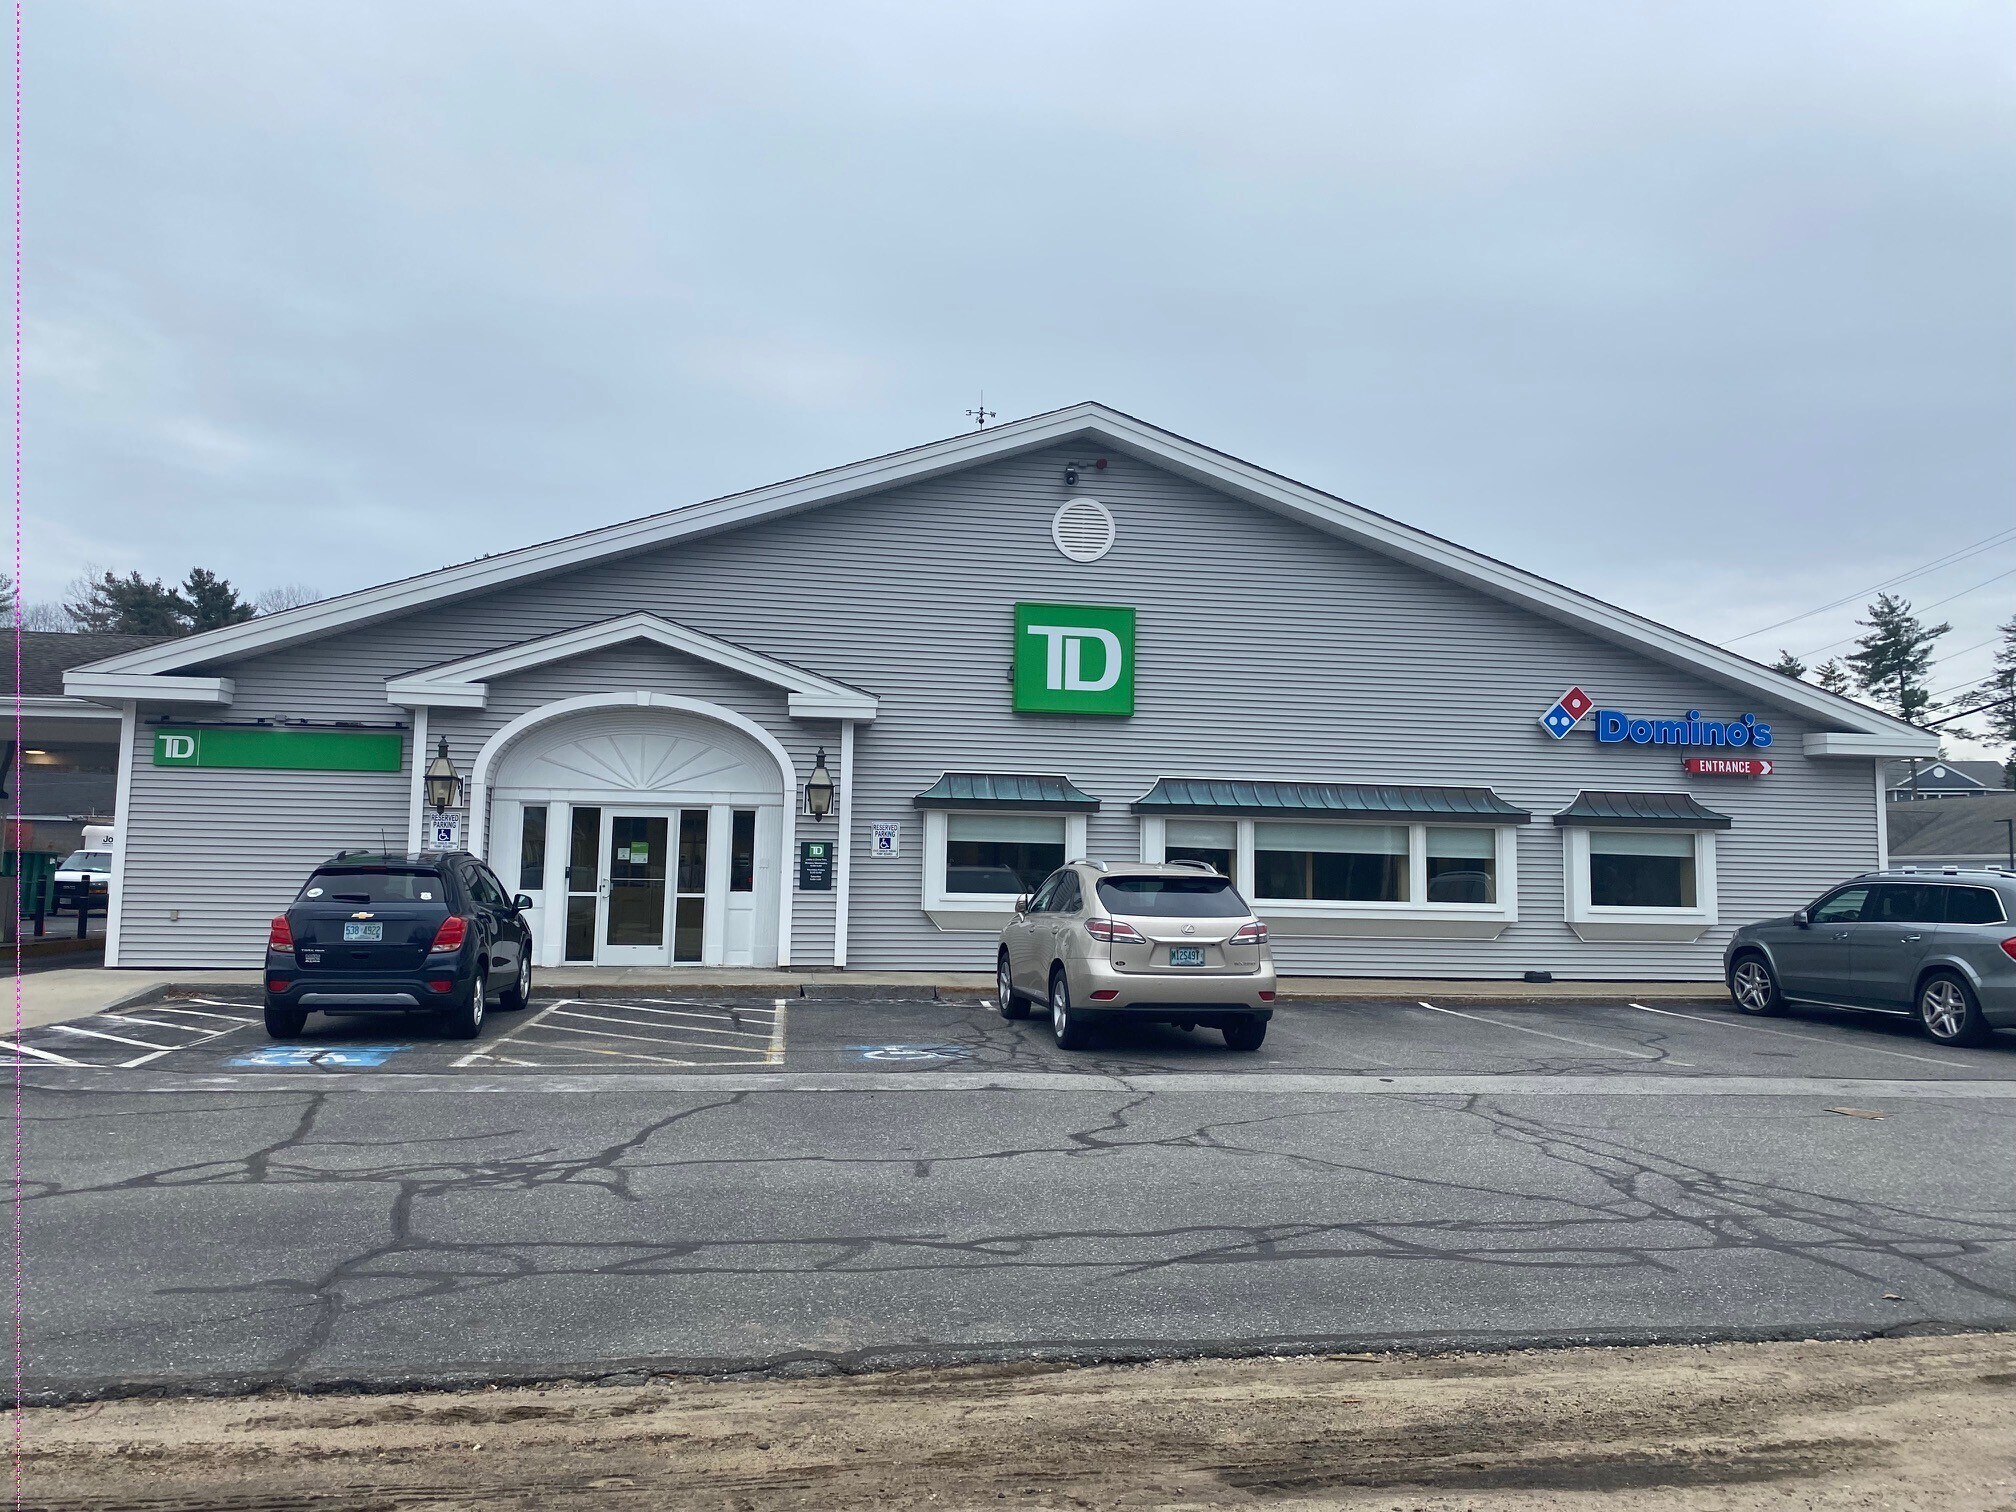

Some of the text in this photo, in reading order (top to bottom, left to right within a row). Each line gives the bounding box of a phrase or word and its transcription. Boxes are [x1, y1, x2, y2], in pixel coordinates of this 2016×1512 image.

[1027, 624, 1122, 692] TD
[1595, 709, 1773, 748] Domino's
[158, 734, 195, 759] TD
[1699, 760, 1751, 773] ENTRANCE
[433, 821, 457, 829] PARKING
[810, 846, 823, 855] TD
